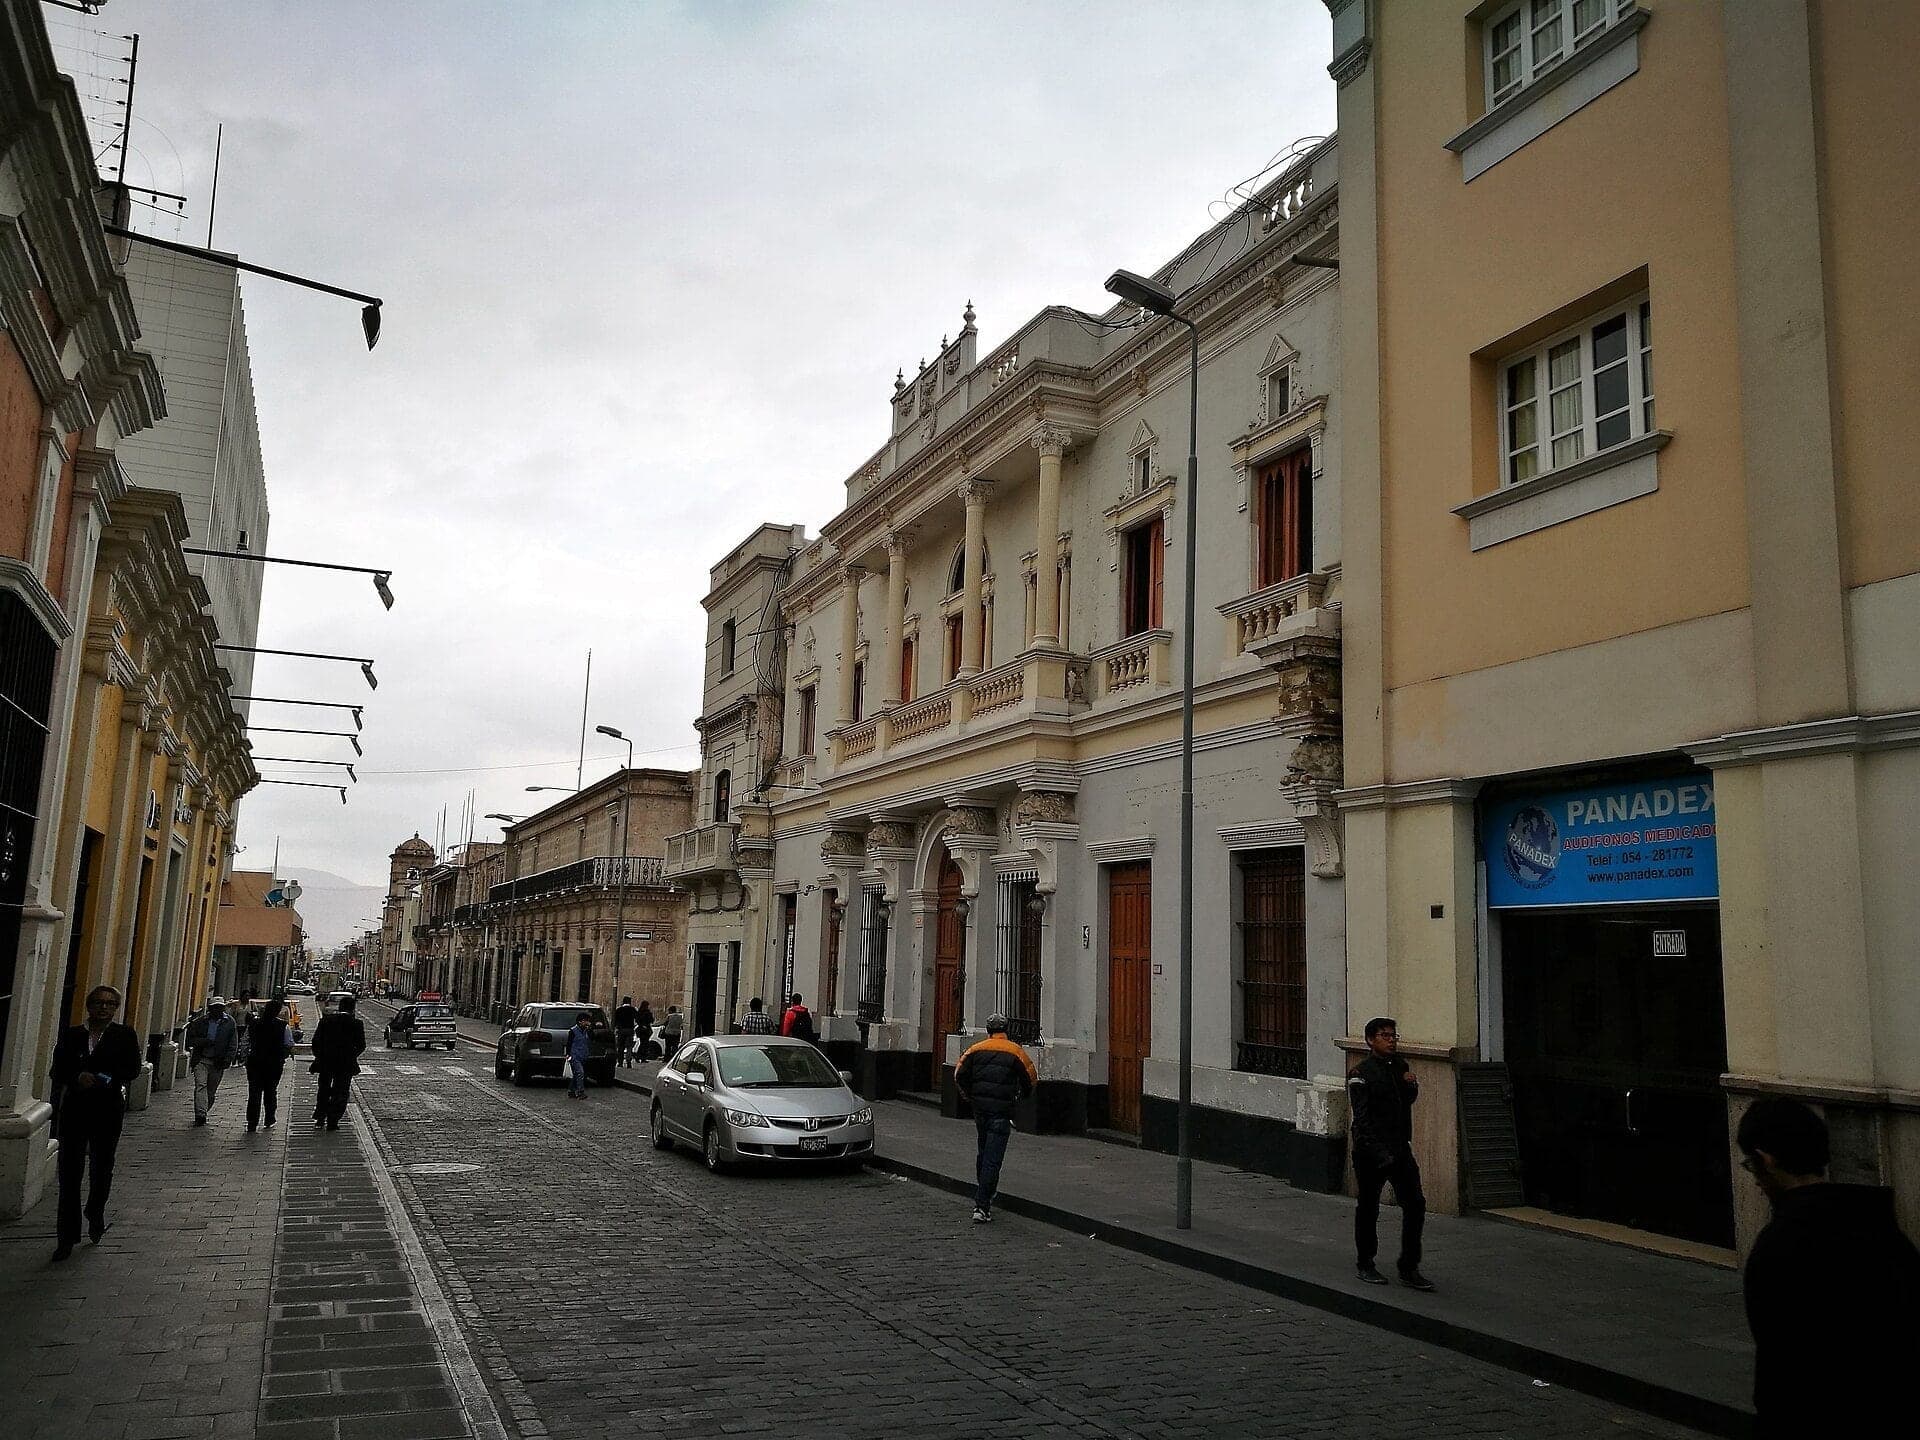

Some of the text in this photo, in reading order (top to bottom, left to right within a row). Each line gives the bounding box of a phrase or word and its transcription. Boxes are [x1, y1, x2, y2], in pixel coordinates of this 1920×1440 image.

[1567, 784, 1714, 827] PANADEX
[1509, 832, 1556, 868] PANADEX
[1563, 830, 1641, 851] AUDIFONOS
[1586, 854, 1612, 867] Telef
[1622, 851, 1642, 864] 054
[1652, 846, 1694, 861] 281772
[1587, 865, 1695, 884] www.panadex.com
[1655, 932, 1685, 953] ENTRADA
